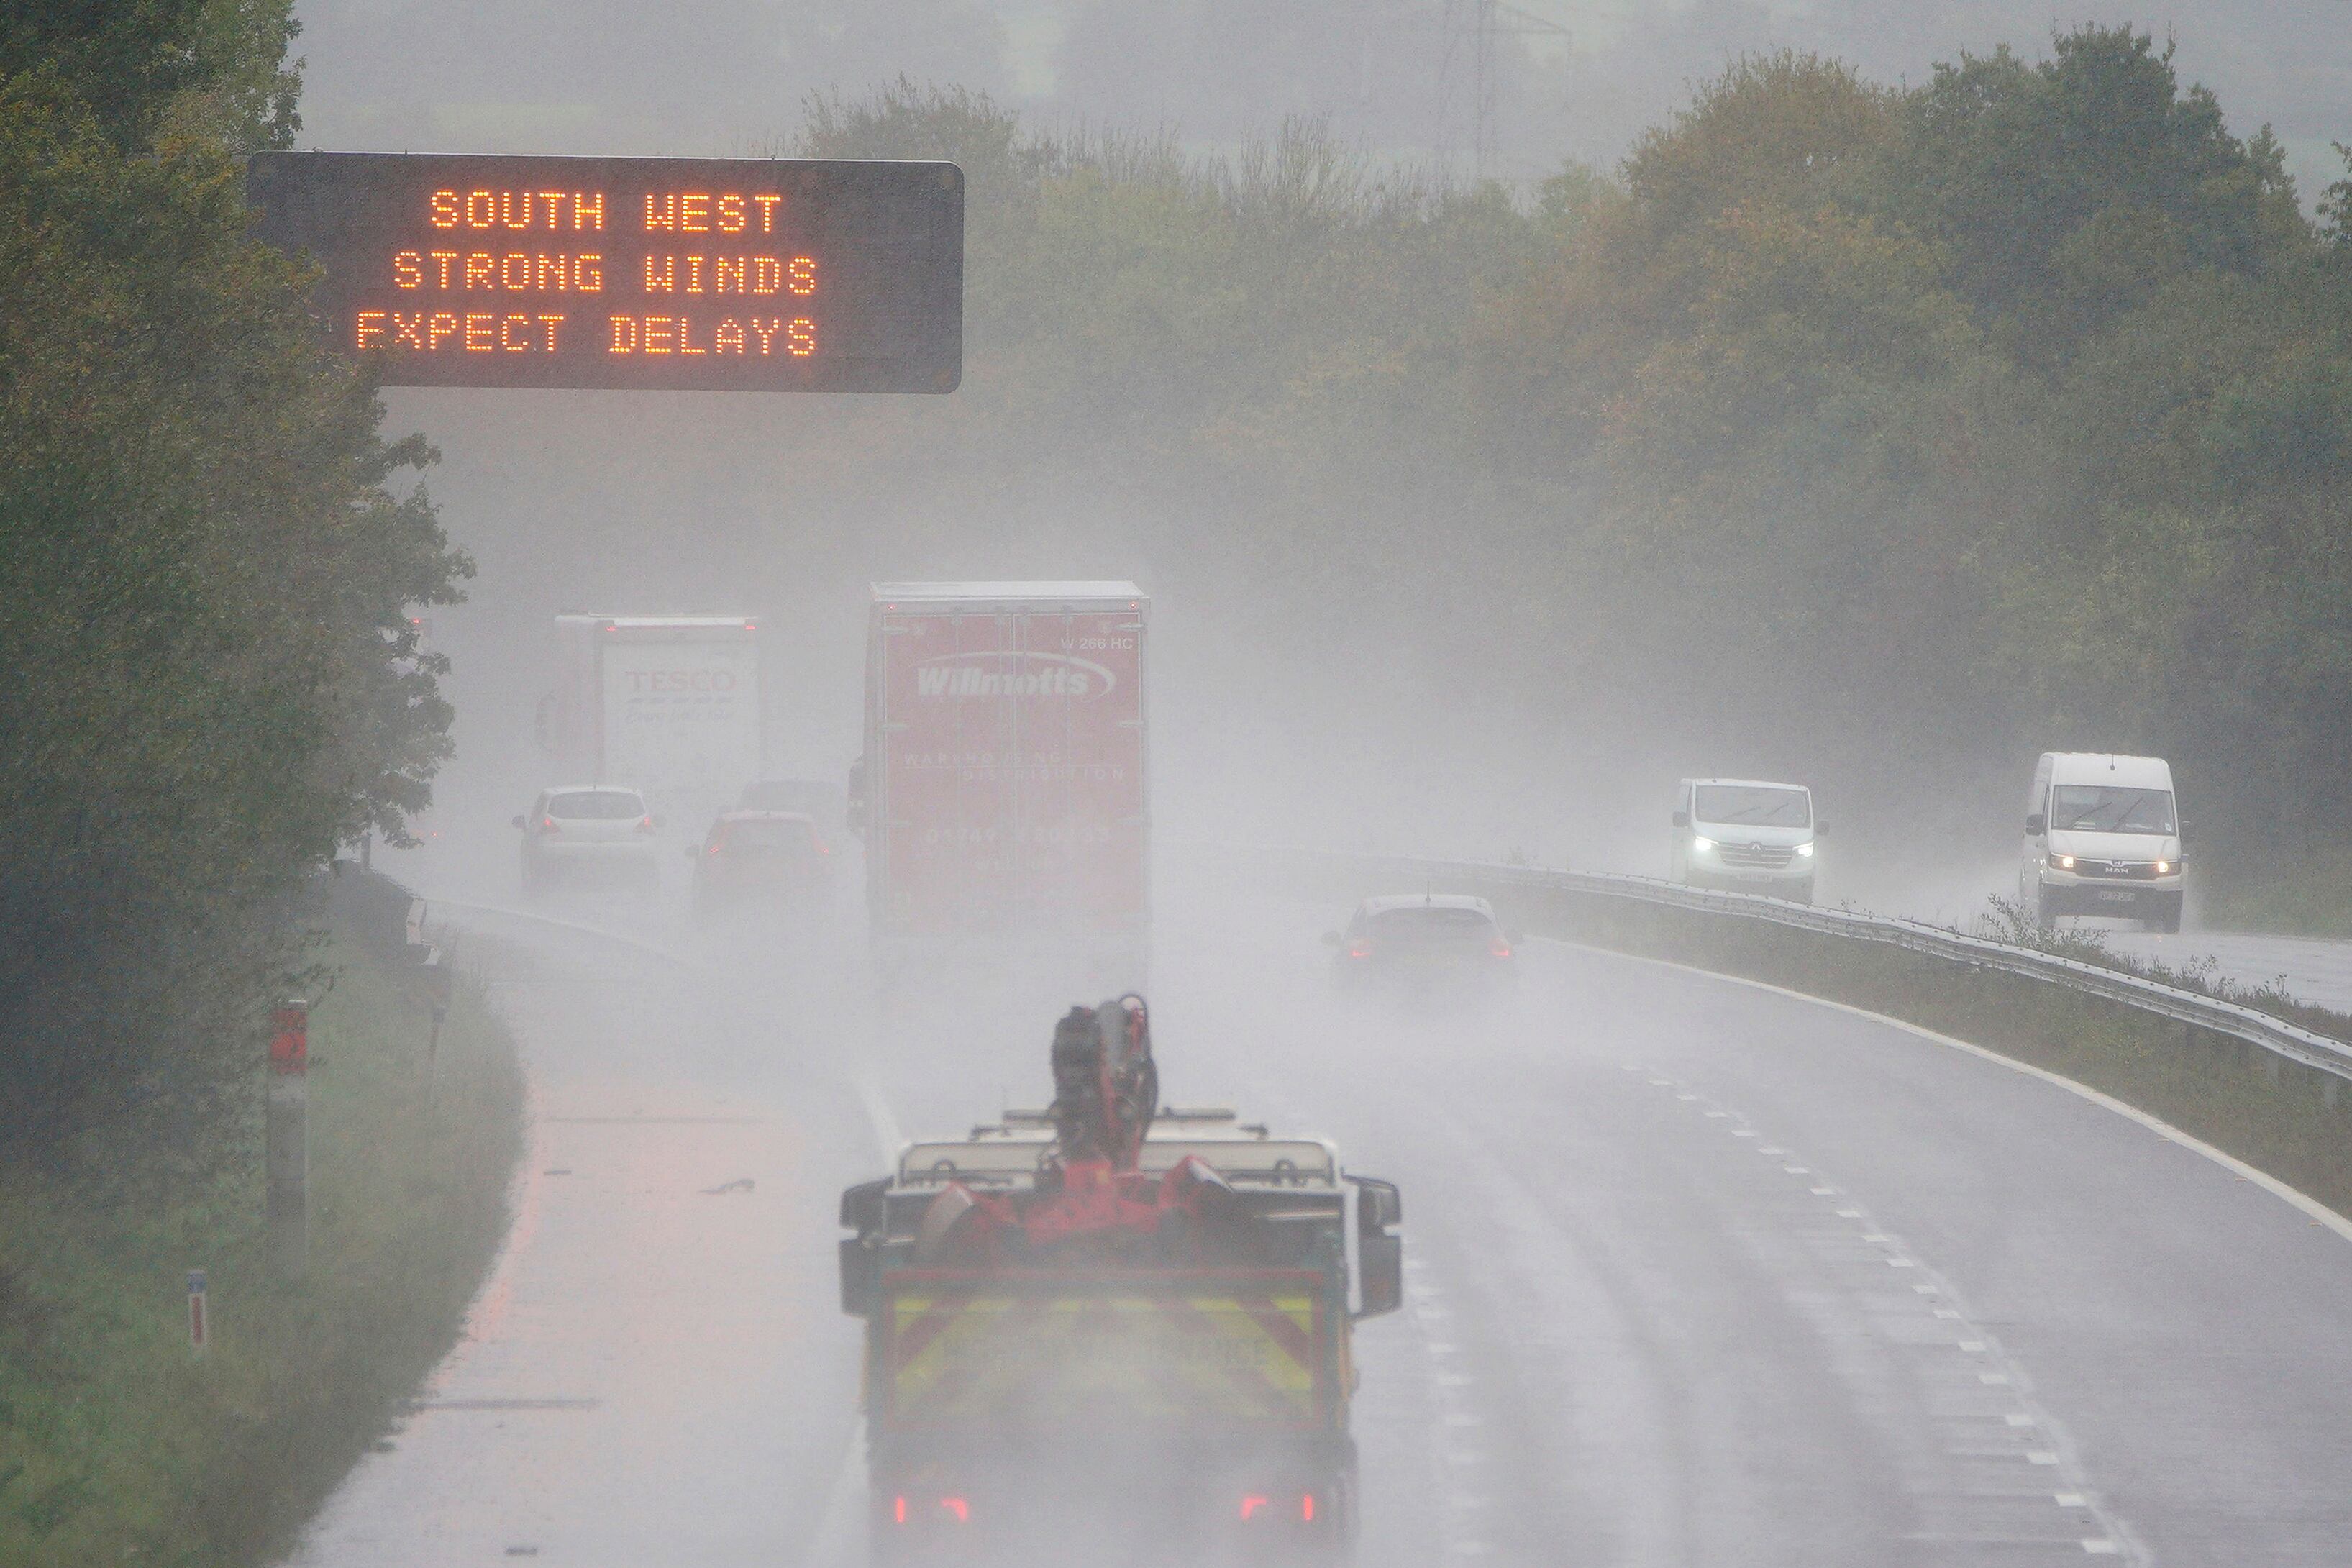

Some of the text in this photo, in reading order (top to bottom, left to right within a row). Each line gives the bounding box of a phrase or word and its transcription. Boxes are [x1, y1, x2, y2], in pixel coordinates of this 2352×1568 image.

[430, 189, 781, 234] SOUTH WEST
[394, 250, 817, 296] STRONG WINDS
[357, 311, 816, 357] EXPECT DELAYS
[1060, 637, 1074, 649] W
[1111, 637, 1134, 649] HC
[624, 670, 737, 692] TESCO
[917, 667, 1089, 696] Willmotts
